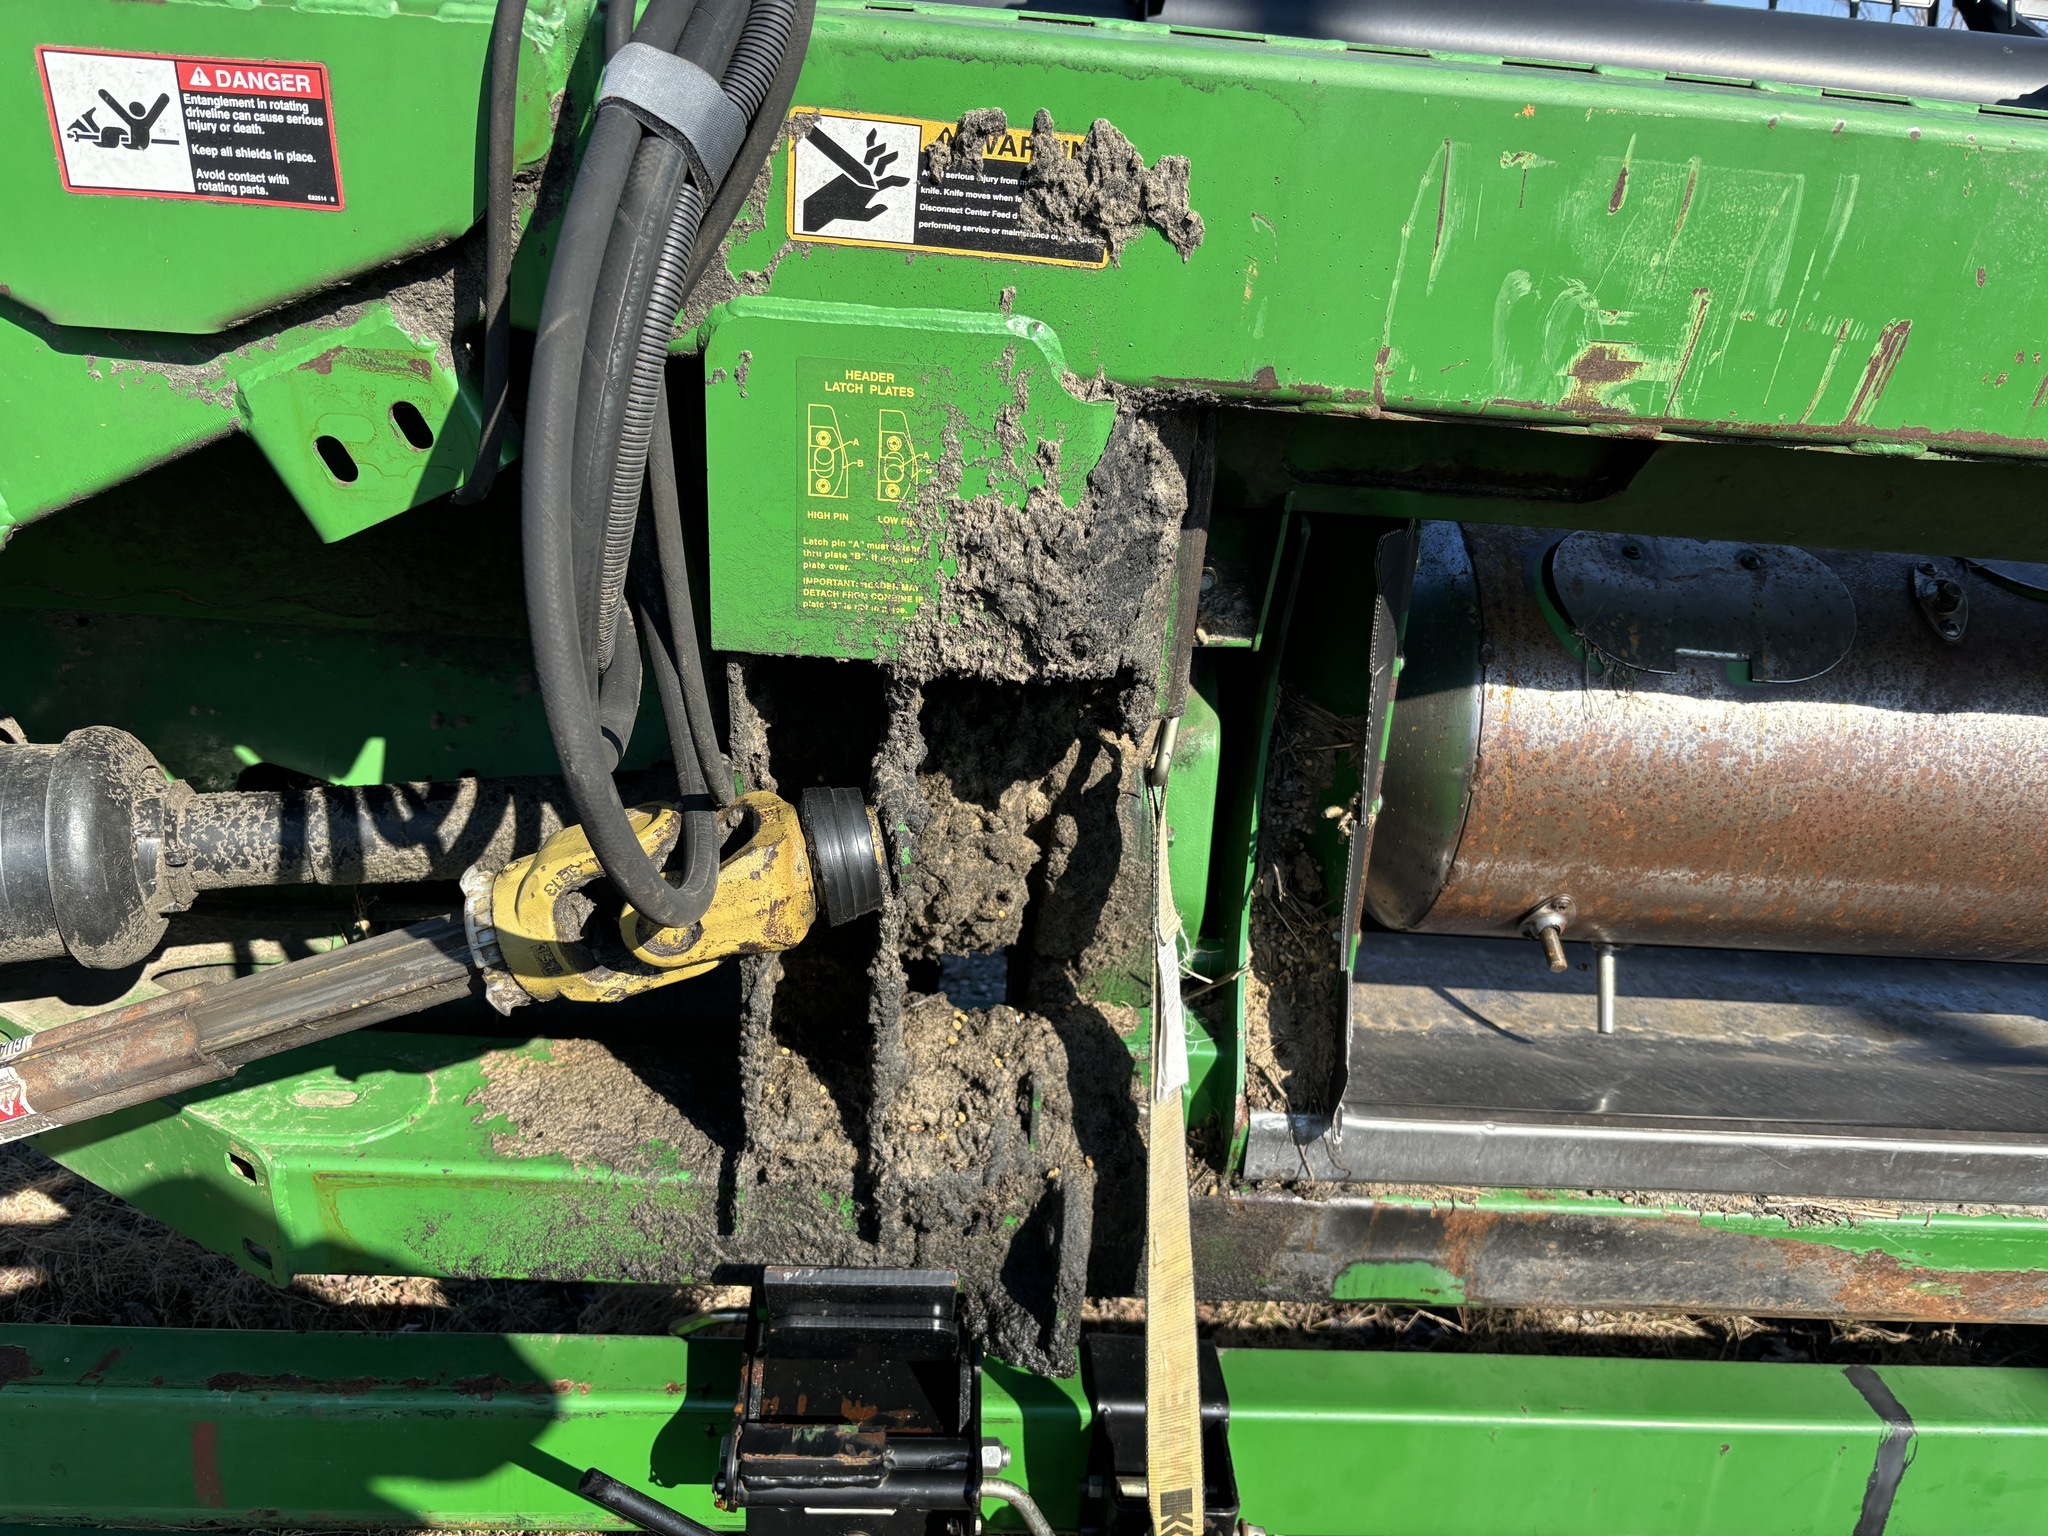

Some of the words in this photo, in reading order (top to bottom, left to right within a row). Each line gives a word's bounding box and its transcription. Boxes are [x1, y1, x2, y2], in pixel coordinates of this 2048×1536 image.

[215, 69, 311, 93] DANGER
[183, 93, 255, 109] Entanglement
[257, 98, 267, 109] in
[270, 100, 309, 114] rotating
[185, 107, 230, 119] driveline
[233, 111, 251, 121] can
[254, 113, 284, 123] cause
[287, 114, 324, 126] serious
[187, 119, 217, 134] injury
[220, 123, 231, 133] or
[233, 123, 265, 135] death.
[191, 144, 218, 158] Keep
[220, 147, 233, 157] all
[236, 148, 272, 160] shields
[274, 150, 284, 161] in
[286, 151, 316, 164] place.
[196, 168, 225, 180] Avoid
[228, 172, 266, 183] contact
[268, 174, 289, 185] with
[946, 172, 974, 181] serious
[1000, 176, 1018, 185] from
[198, 181, 237, 195] rotating
[240, 185, 269, 196] parts.
[920, 186, 942, 196] knife.
[944, 188, 964, 197] Knife
[966, 192, 992, 200] moves
[992, 194, 1013, 202] when
[920, 204, 964, 214] Disconnect
[964, 207, 990, 216] Center
[992, 210, 1011, 219] Feed
[918, 221, 961, 232] performing
[962, 225, 990, 234] service
[846, 370, 895, 383] HEADER
[824, 381, 864, 394] LATCH
[870, 384, 914, 398] PLATES
[852, 438, 860, 446] A
[807, 511, 831, 520] HIGH
[834, 512, 849, 521] PIN
[878, 515, 898, 524] LOW
[804, 537, 828, 546] Latch
[831, 539, 846, 548] pin
[803, 550, 822, 558] thru
[824, 550, 848, 560] plate
[803, 561, 826, 570] plate
[803, 578, 858, 588] IMPORTANT:
[803, 588, 840, 598] DETACH
[842, 591, 868, 600] FROM
[802, 600, 824, 608] plate
